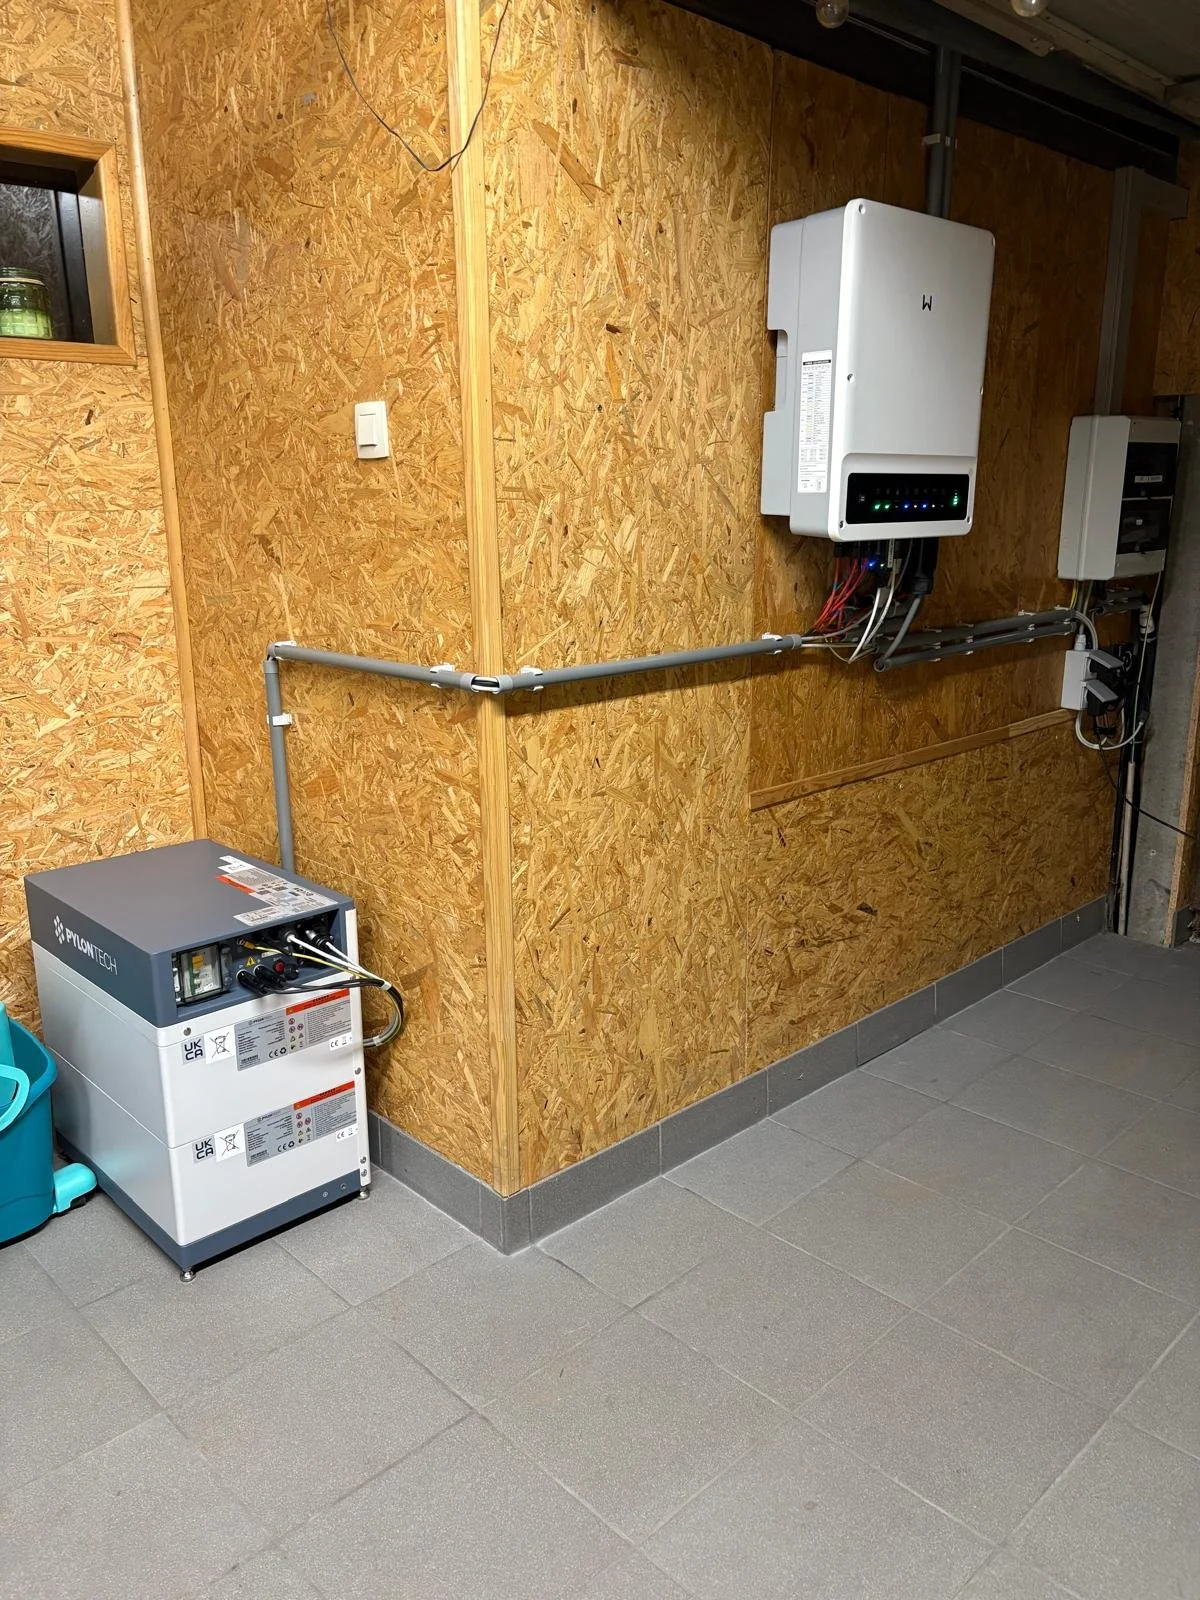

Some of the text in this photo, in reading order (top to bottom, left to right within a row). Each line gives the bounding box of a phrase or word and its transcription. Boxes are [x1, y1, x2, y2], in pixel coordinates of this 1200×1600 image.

[65, 927, 118, 976] PYLONTECH
[184, 1038, 202, 1052] UK
[185, 1048, 203, 1061] CA
[195, 1138, 212, 1151] UK
[196, 1147, 214, 1160] CA
